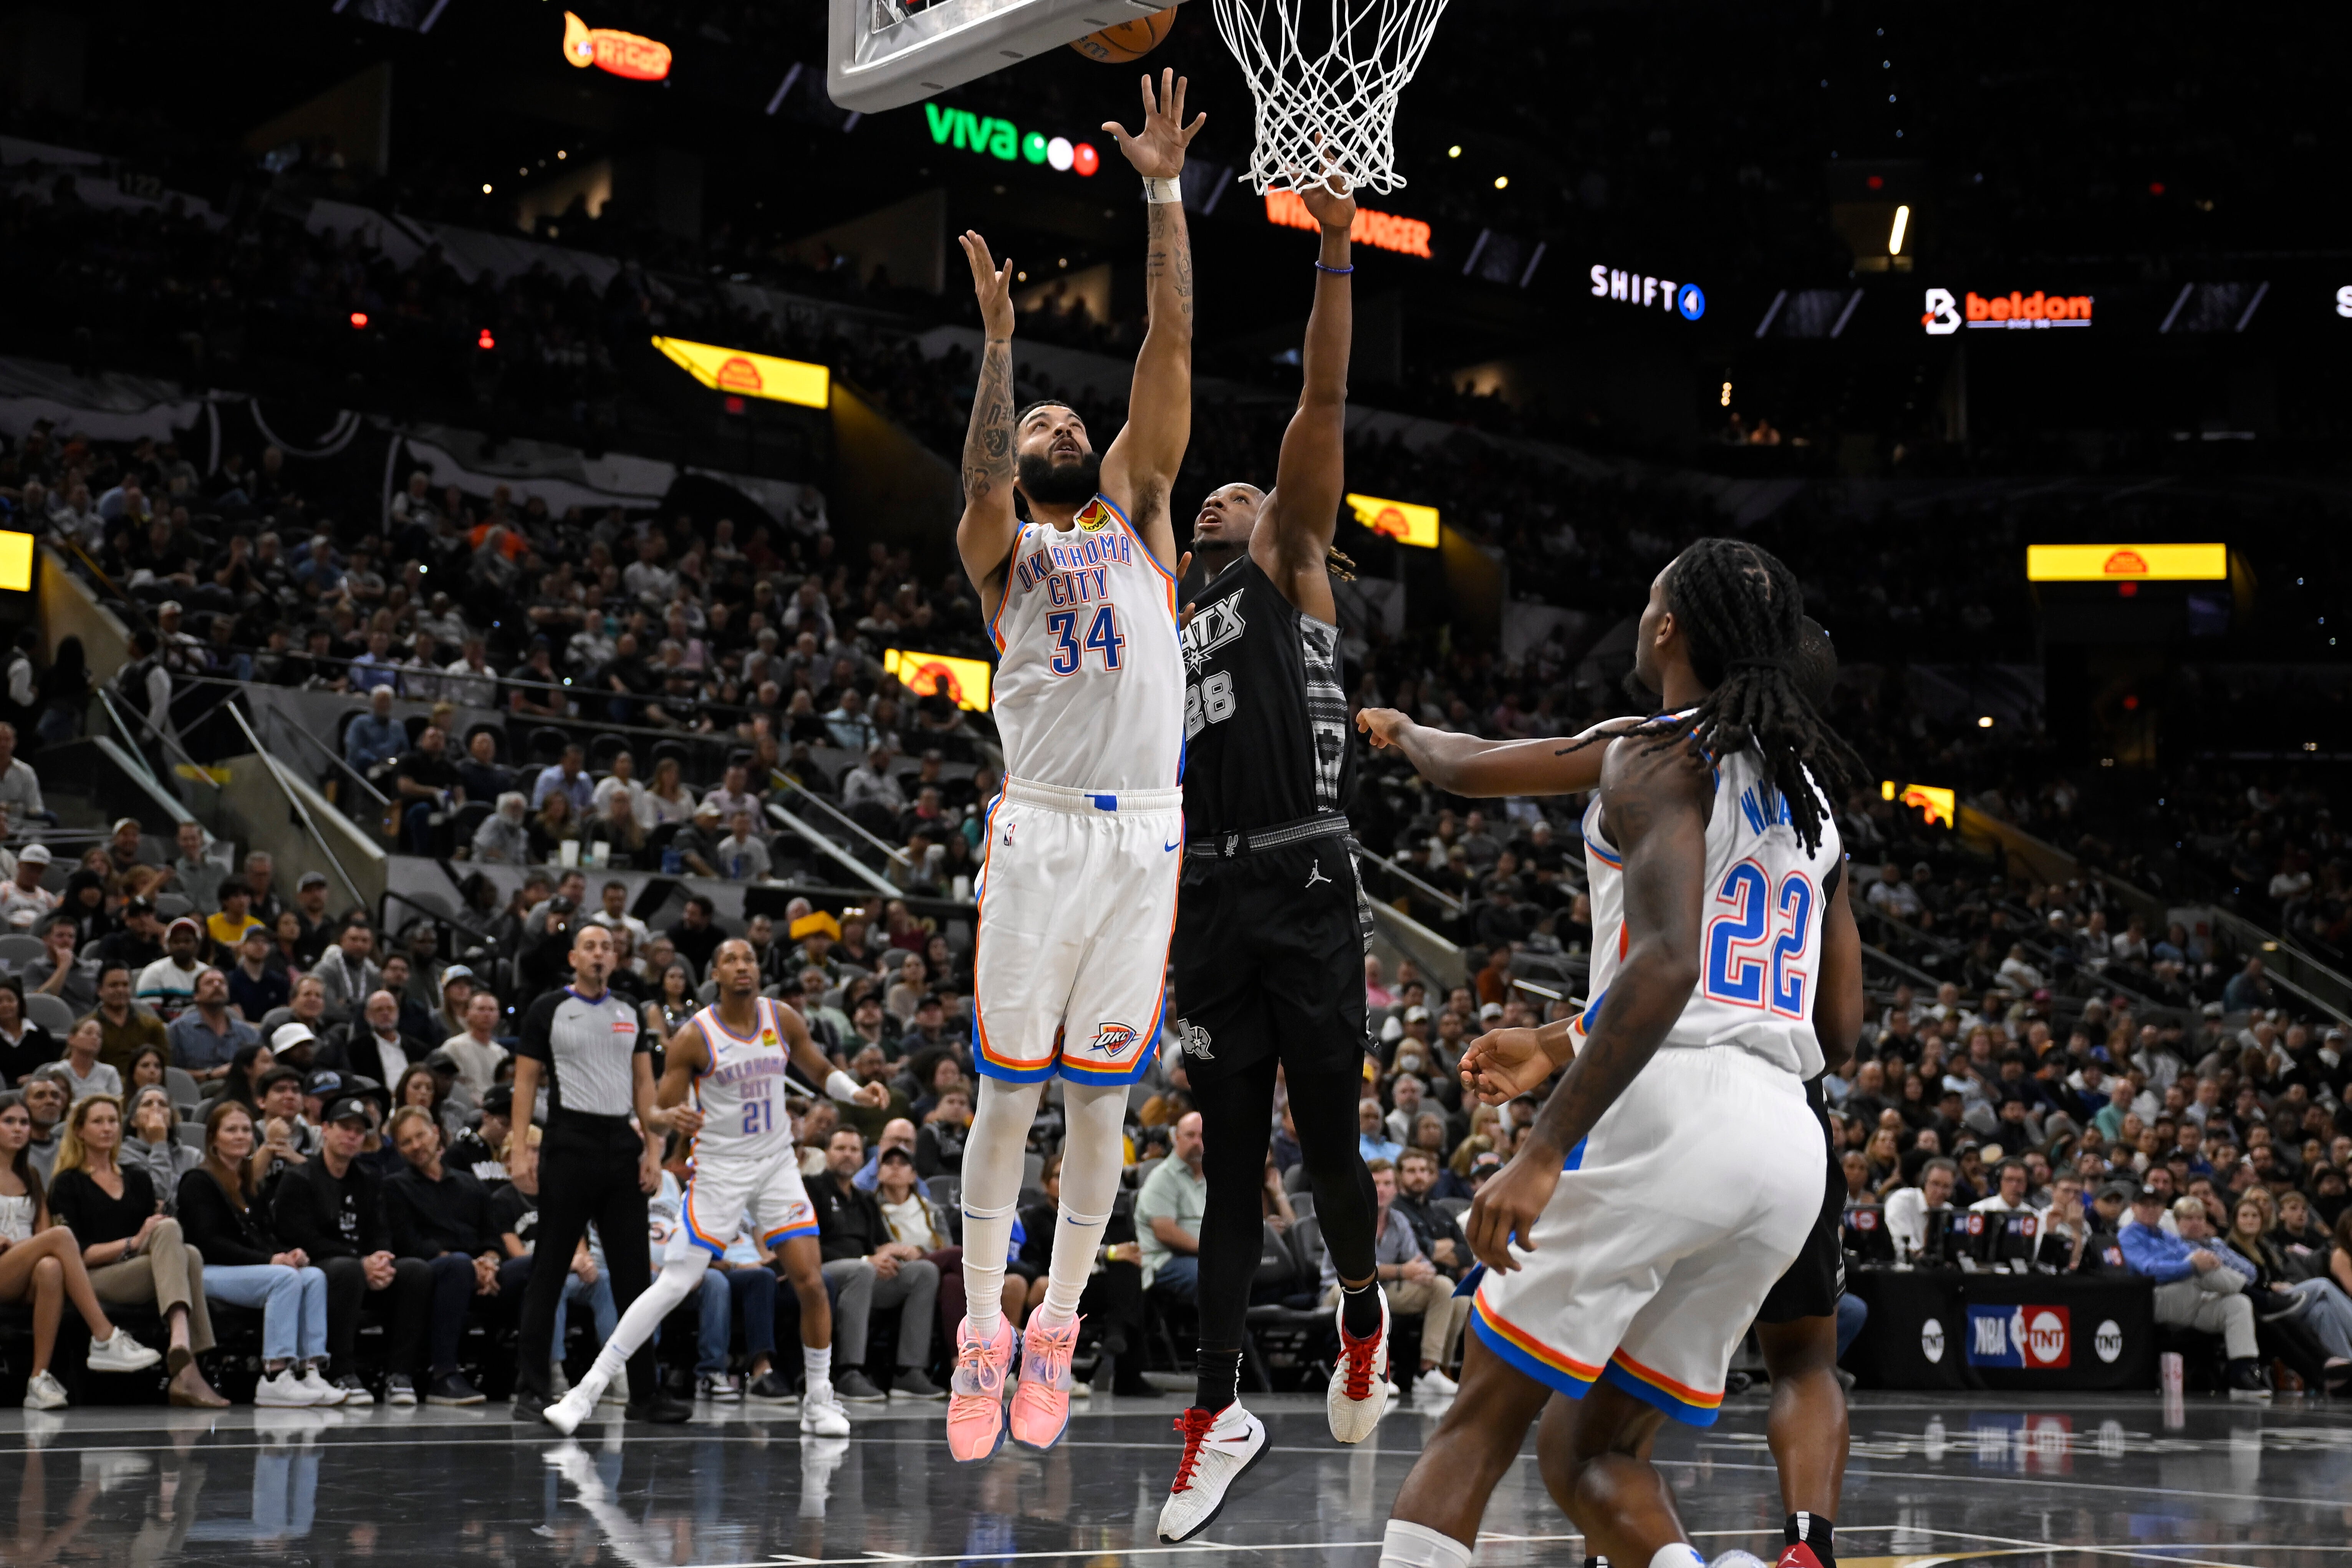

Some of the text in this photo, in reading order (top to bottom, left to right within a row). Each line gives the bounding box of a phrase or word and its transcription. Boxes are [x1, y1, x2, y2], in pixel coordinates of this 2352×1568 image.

[1965, 291, 2092, 320] beldon
[1016, 533, 1132, 592] OKLAHOMA
[1047, 565, 1108, 608] CITY
[1045, 603, 1126, 677] 34
[1184, 670, 1236, 740] 28
[1703, 856, 1814, 1020] 22
[1095, 1032, 1129, 1046] OKC
[743, 1098, 772, 1135] 21
[1974, 1316, 2065, 1356] NBA TNT
